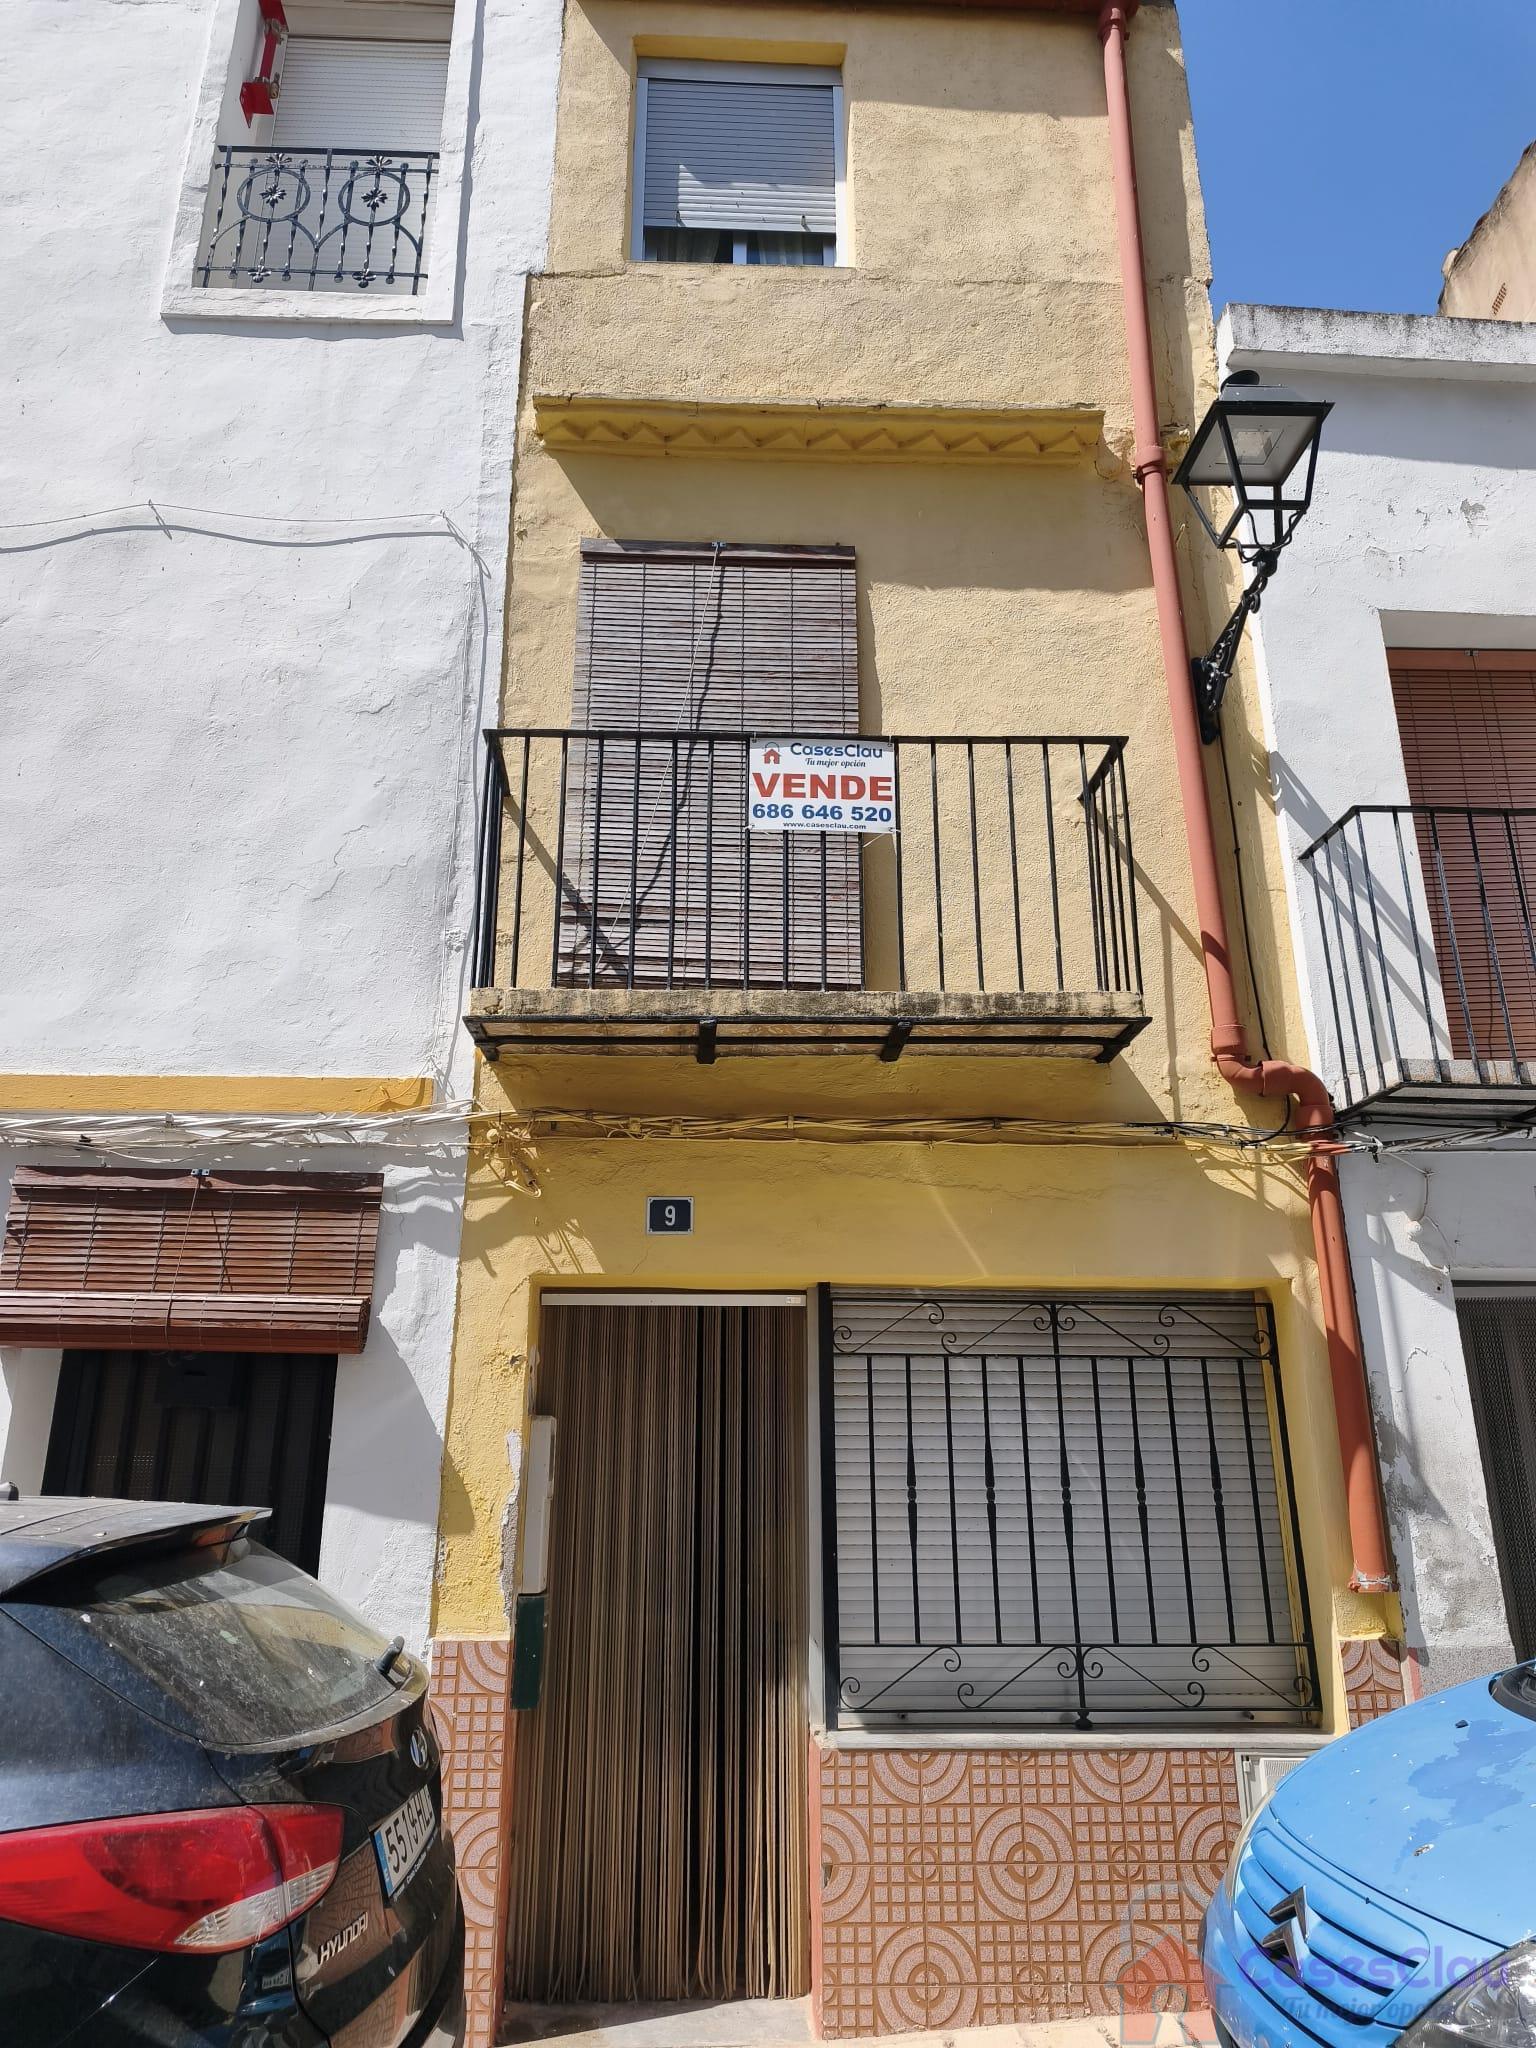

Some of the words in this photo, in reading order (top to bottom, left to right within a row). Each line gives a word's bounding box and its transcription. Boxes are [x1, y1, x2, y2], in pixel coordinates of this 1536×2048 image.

[790, 742, 883, 758] CasesClau
[805, 757, 815, 766] Tu
[816, 759, 839, 769] mejor
[840, 759, 866, 769] opción
[752, 772, 893, 801] VENDE
[752, 803, 794, 819] 686
[801, 804, 843, 820] 646
[851, 806, 892, 822] 520
[782, 821, 867, 830] www.casesclau.com
[664, 1205, 676, 1226] 9
[319, 1911, 369, 1967] HYUNDAI
